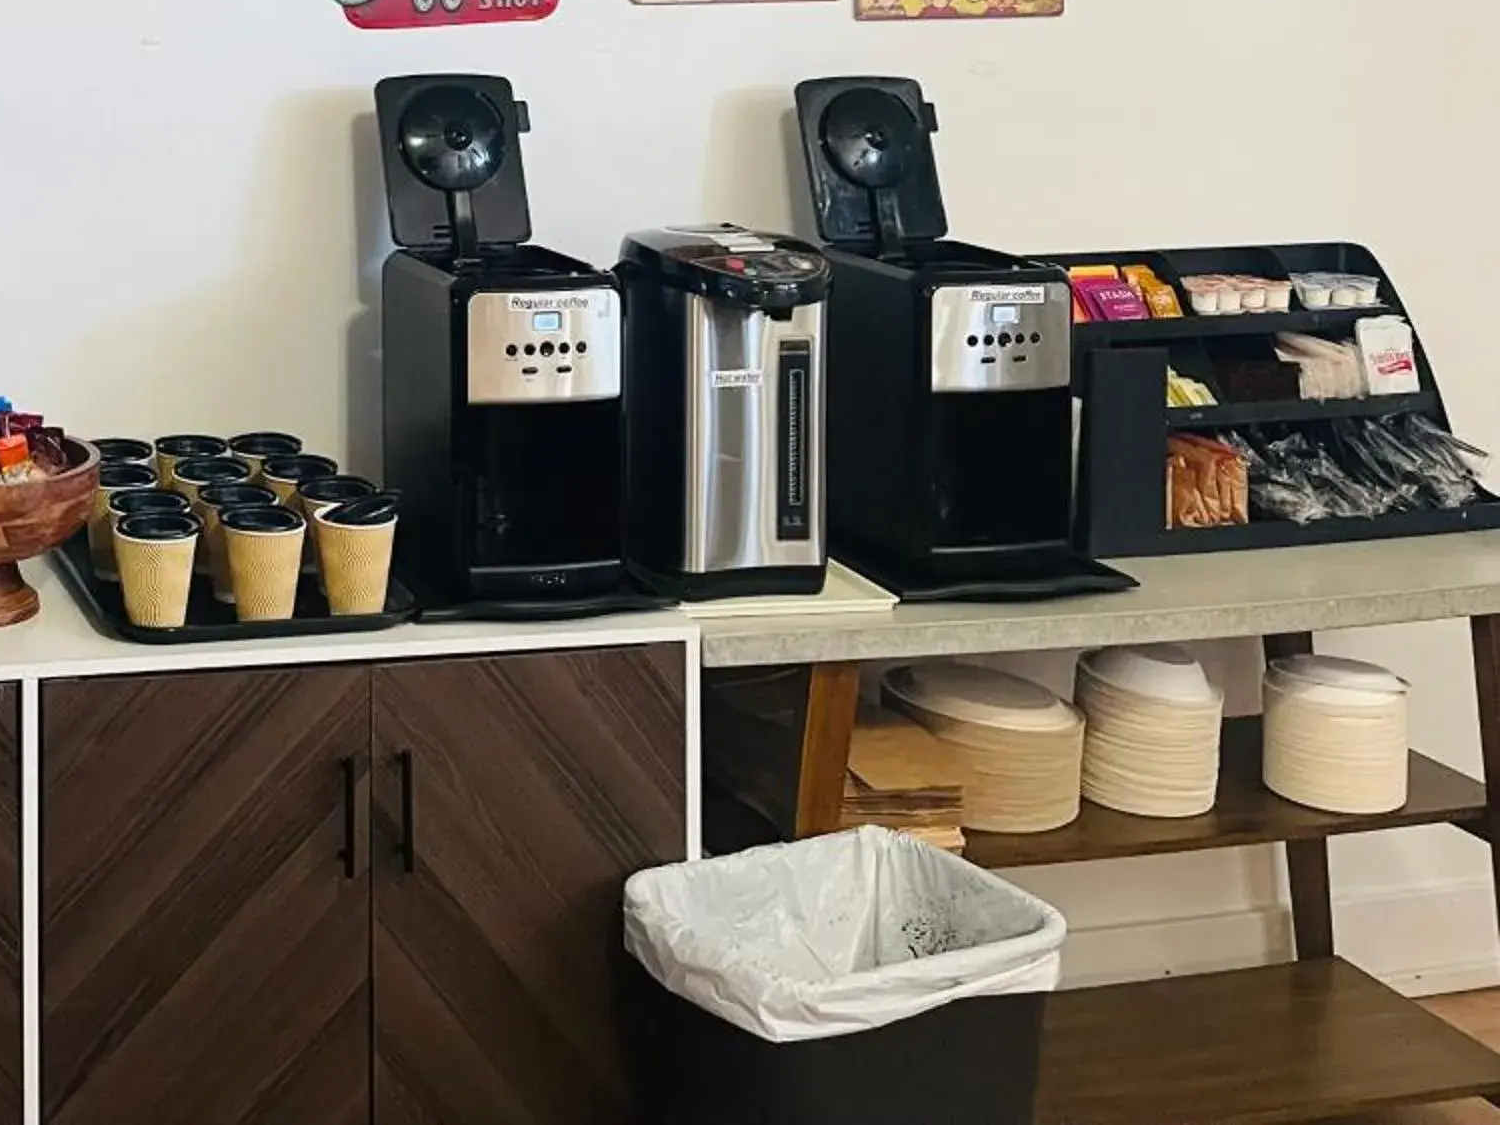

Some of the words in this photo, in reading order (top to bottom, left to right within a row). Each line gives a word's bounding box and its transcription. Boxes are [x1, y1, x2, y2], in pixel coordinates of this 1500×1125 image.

[971, 290, 1009, 302] Regular
[1012, 289, 1041, 301] coffee
[1100, 289, 1135, 301] STASH
[511, 296, 553, 309] Regular
[556, 296, 589, 308] coffee
